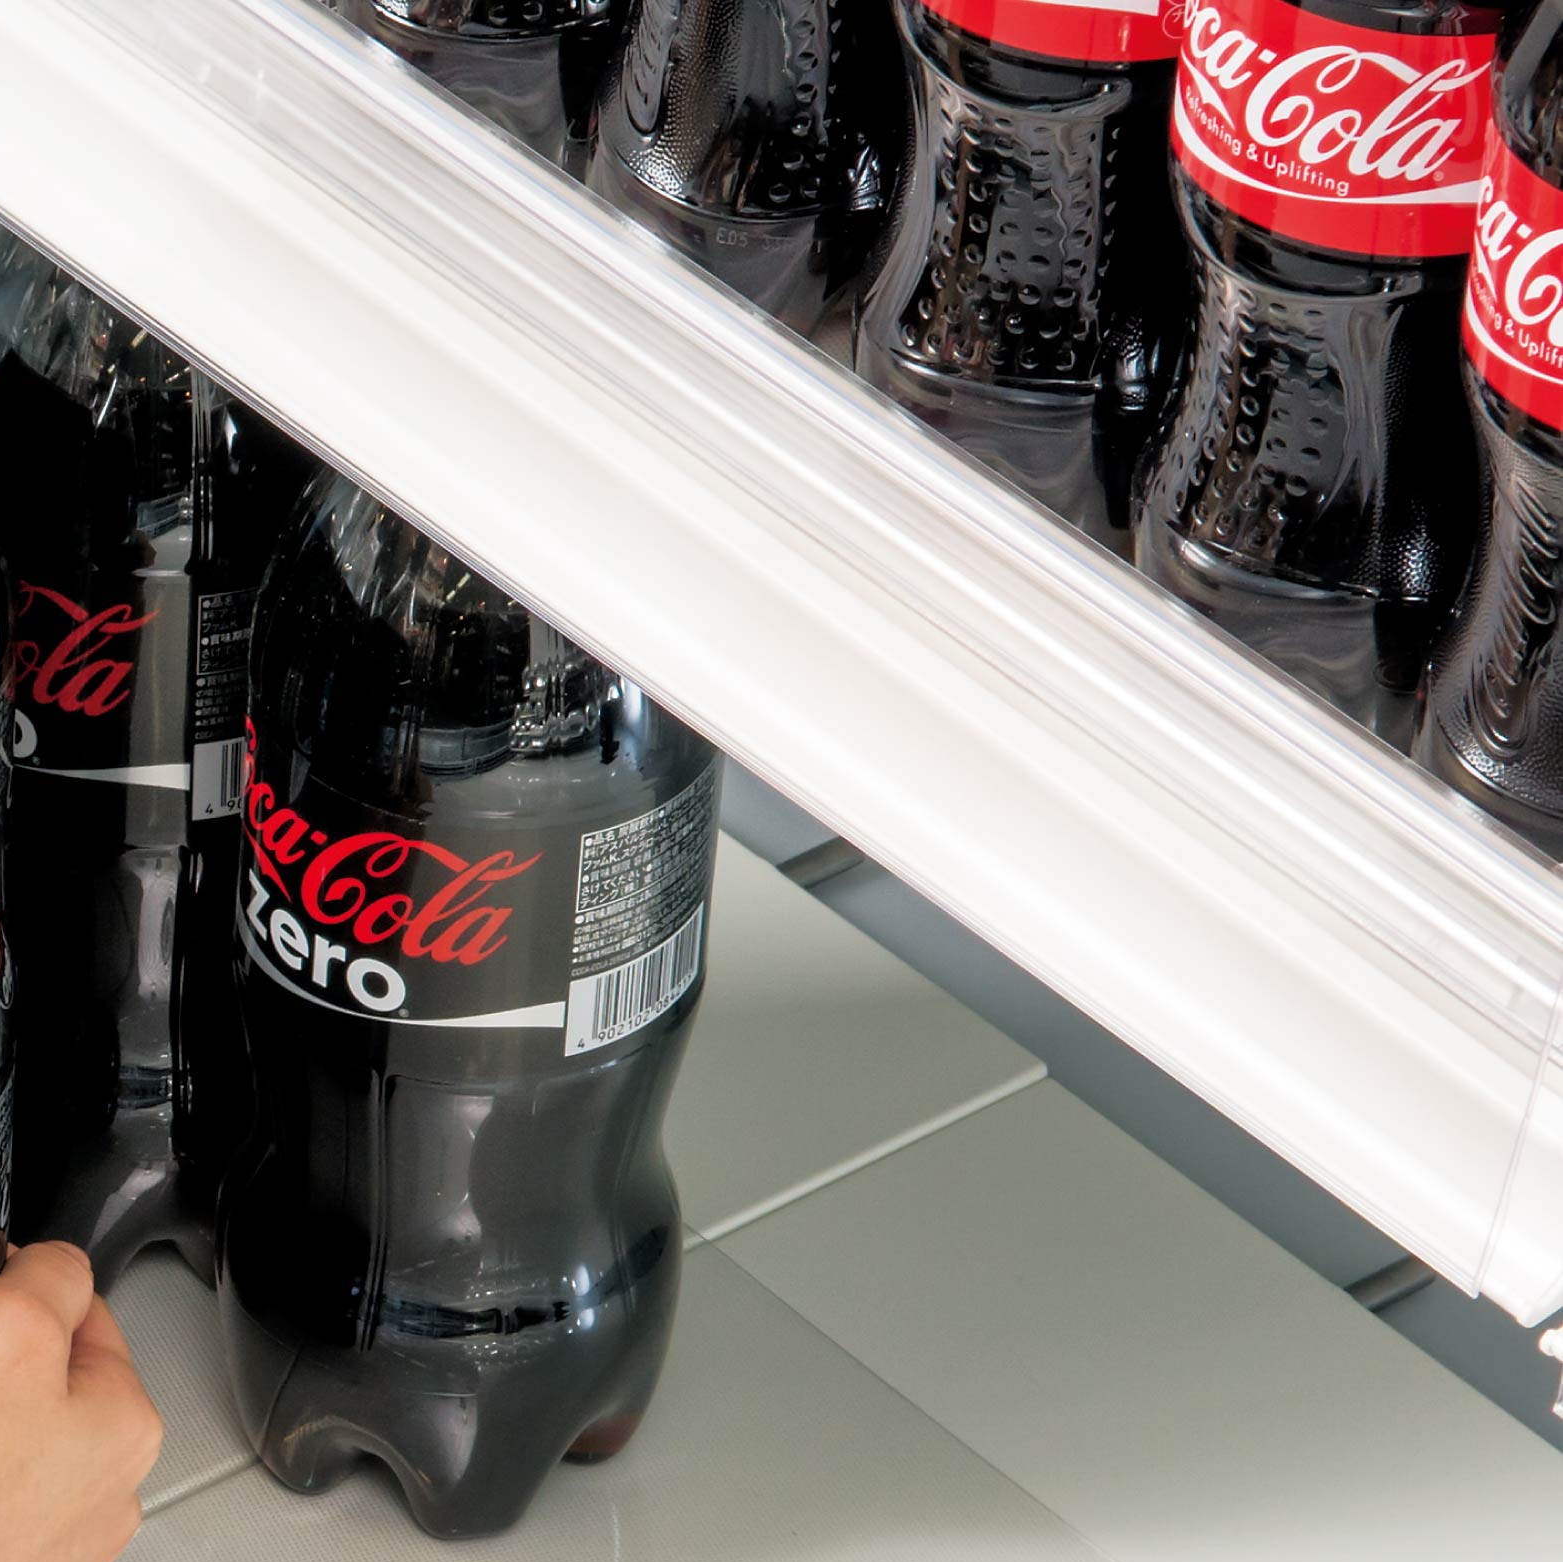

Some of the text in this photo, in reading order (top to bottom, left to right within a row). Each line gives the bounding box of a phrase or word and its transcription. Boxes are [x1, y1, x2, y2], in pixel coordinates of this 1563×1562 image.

[1183, 0, 1491, 181] oca-Cola
[1246, 143, 1259, 163] &
[1264, 150, 1350, 197] Uplifting
[244, 715, 545, 967] ca-Cola
[246, 868, 407, 1012] zero
[577, 1037, 586, 1049] 4
[598, 1010, 651, 1042] 902102
